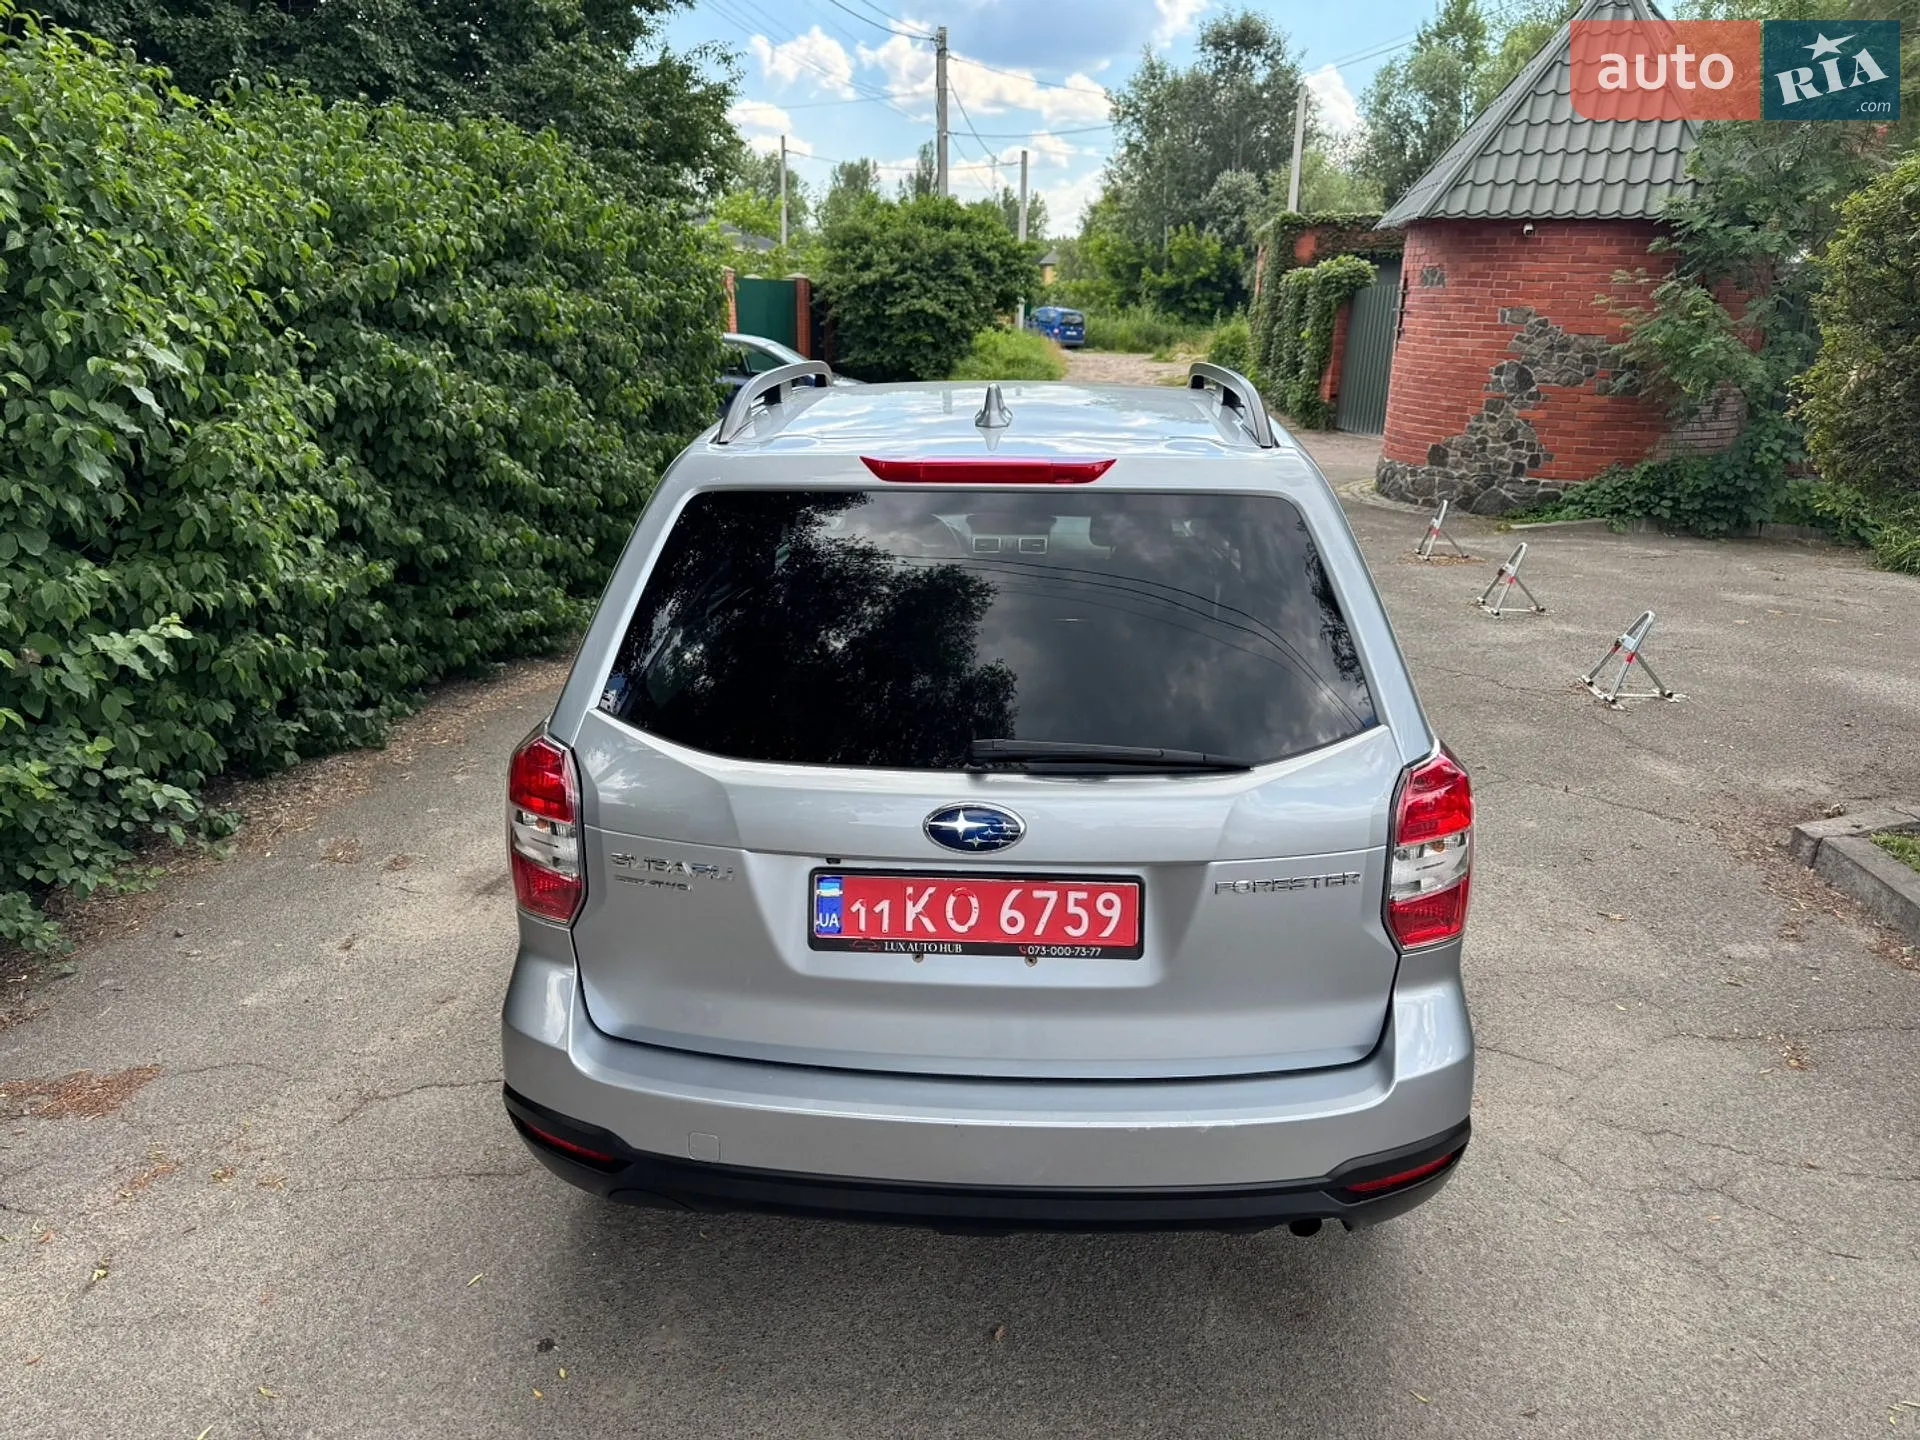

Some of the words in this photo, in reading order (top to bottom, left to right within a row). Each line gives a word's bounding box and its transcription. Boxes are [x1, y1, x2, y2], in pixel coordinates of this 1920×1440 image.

[1214, 871, 1361, 895] FORESTER
[818, 912, 840, 928] UA
[850, 898, 890, 933] 11
[1000, 888, 1122, 938] 6759
[884, 941, 905, 952] LUX
[906, 942, 938, 953] AUTO
[940, 943, 962, 954] HUB
[1027, 945, 1102, 957] 073-000-73-77
